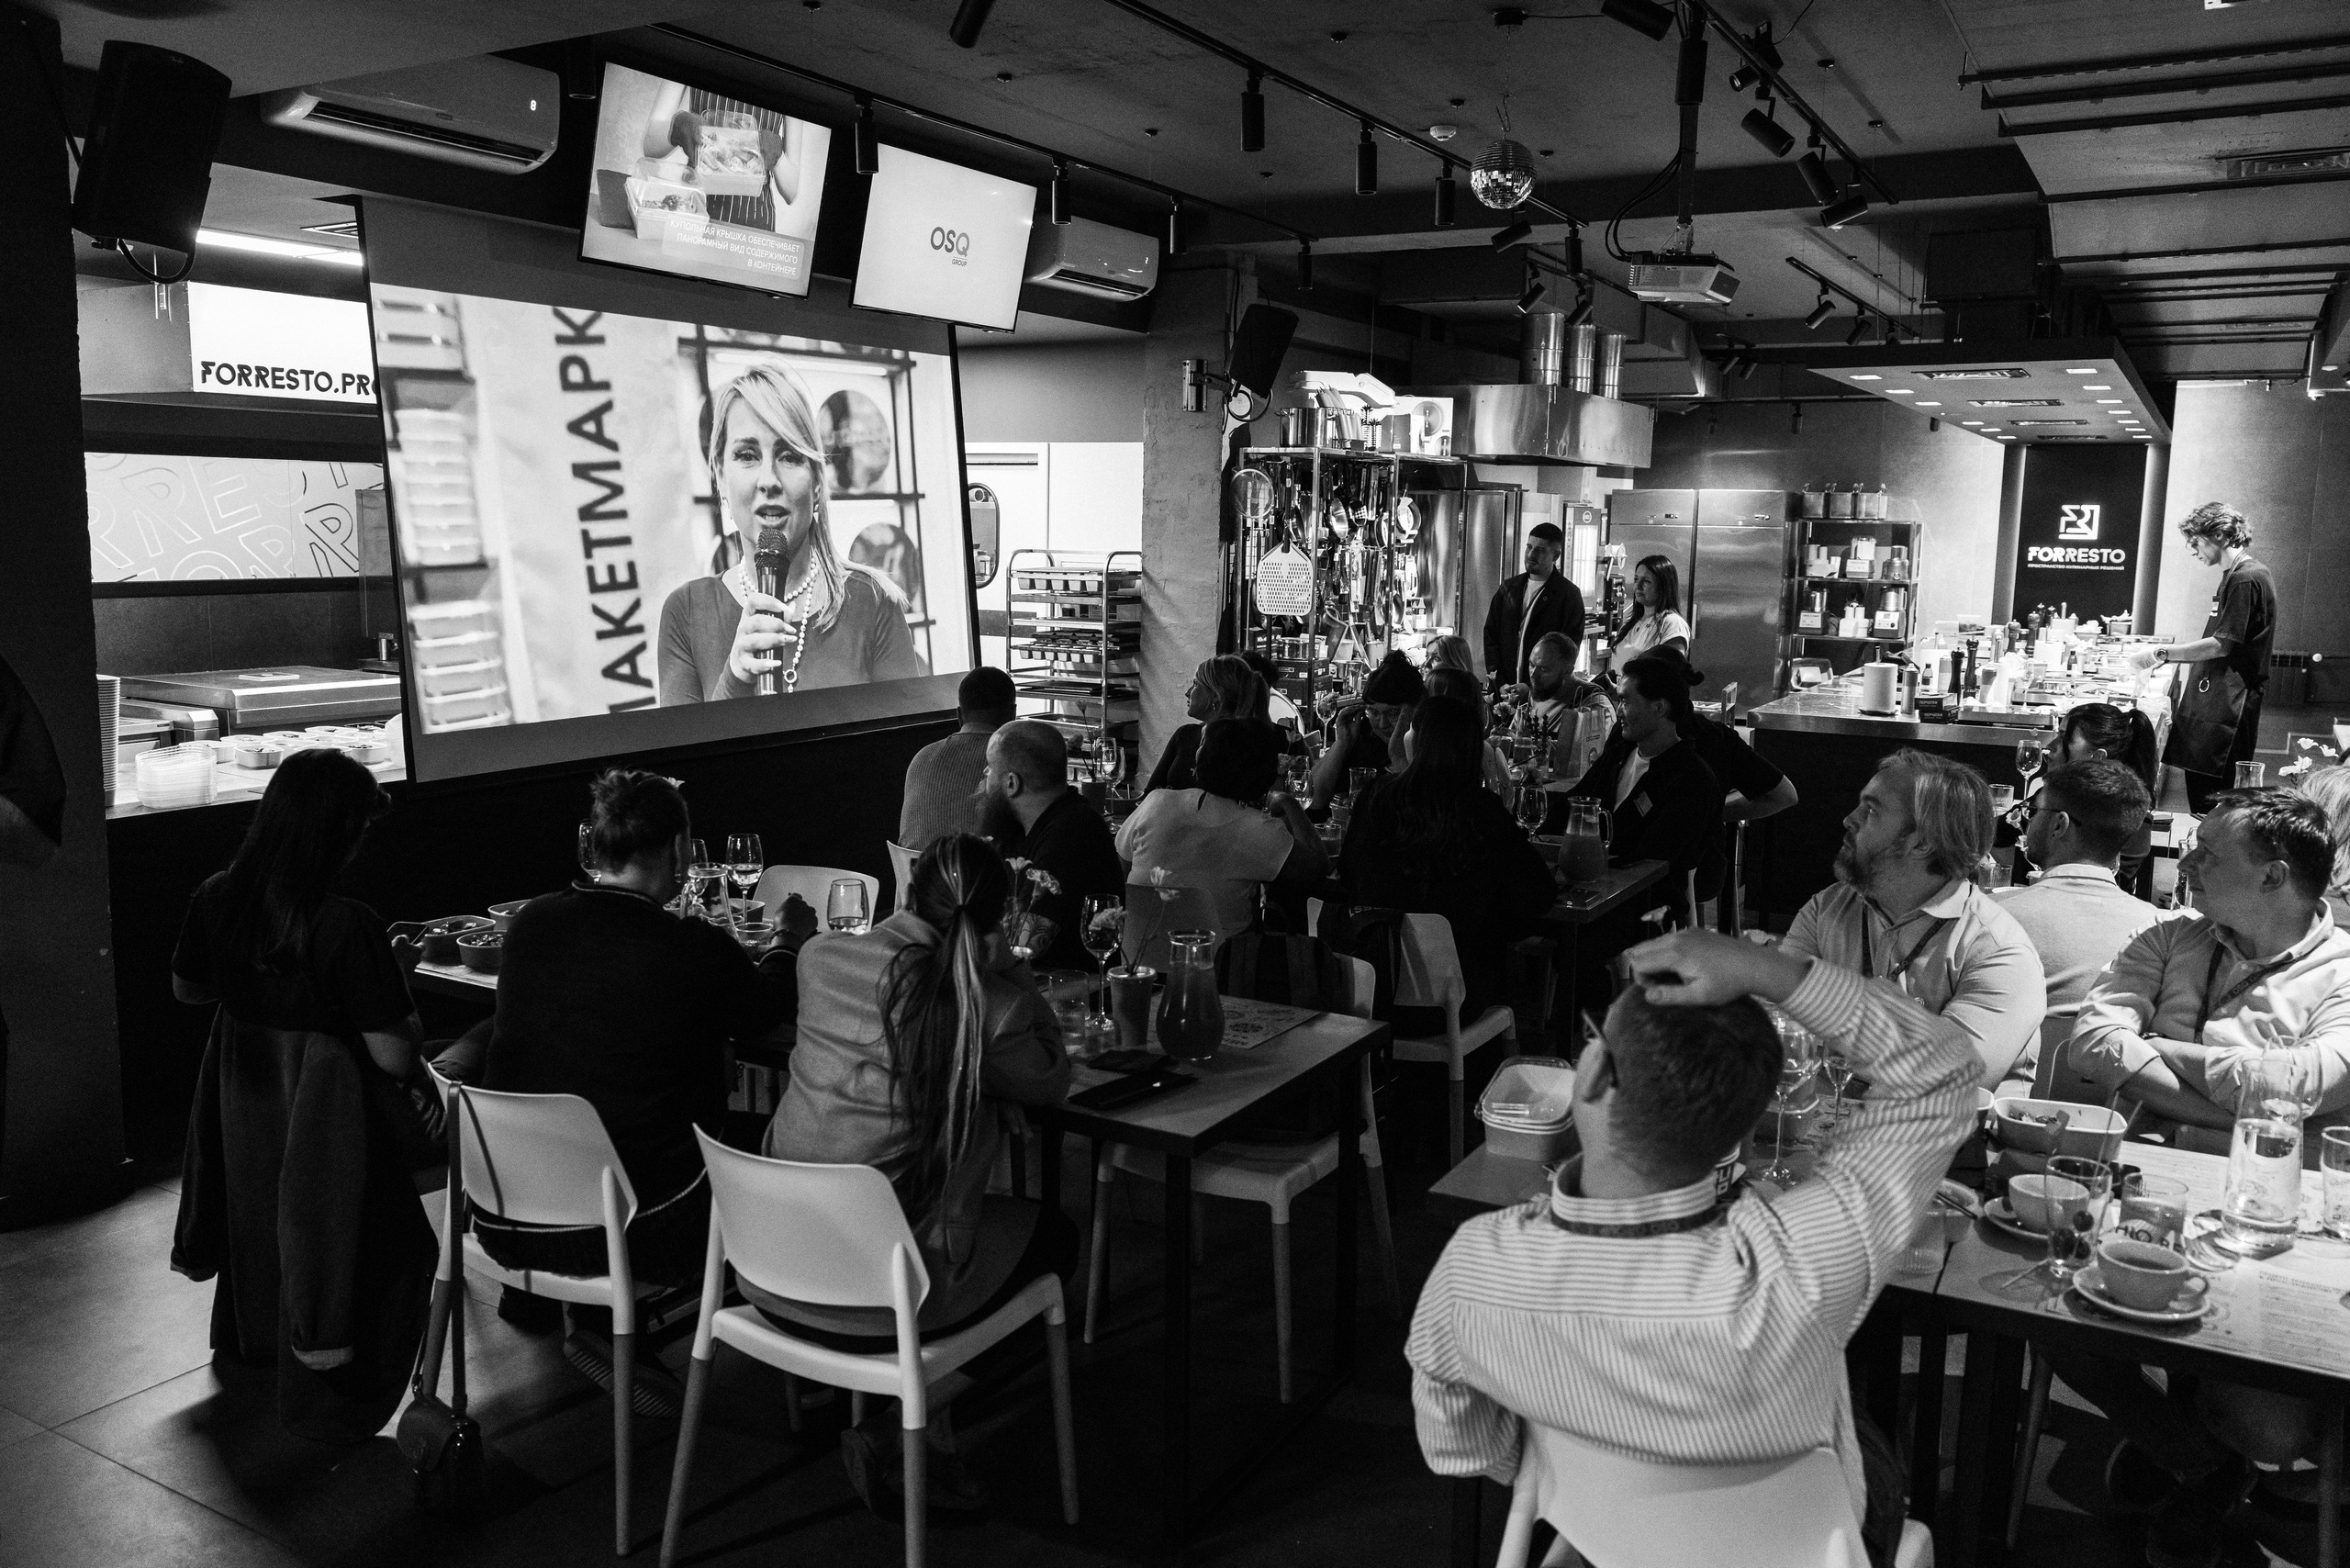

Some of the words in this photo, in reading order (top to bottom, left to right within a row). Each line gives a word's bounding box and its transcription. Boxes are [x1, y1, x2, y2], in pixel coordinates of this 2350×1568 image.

[670, 219, 715, 235] КУПОЛЬНАЯ
[716, 229, 747, 242] КРЫШКА
[748, 235, 800, 253] ОБЕСПЕЧИВАЕТ
[677, 232, 729, 250] ПАНОРАМНЫЙ
[730, 244, 745, 255] ВИД
[745, 248, 799, 264] СОДЕРЖИМОГО
[930, 226, 970, 258] OSQ
[747, 259, 753, 267] В
[754, 260, 797, 275] КОНТЕЙНЕРЕ
[951, 258, 968, 267] GROUP
[200, 361, 377, 396] FORRESTO.PR
[2027, 546, 2126, 564] FORRESTO
